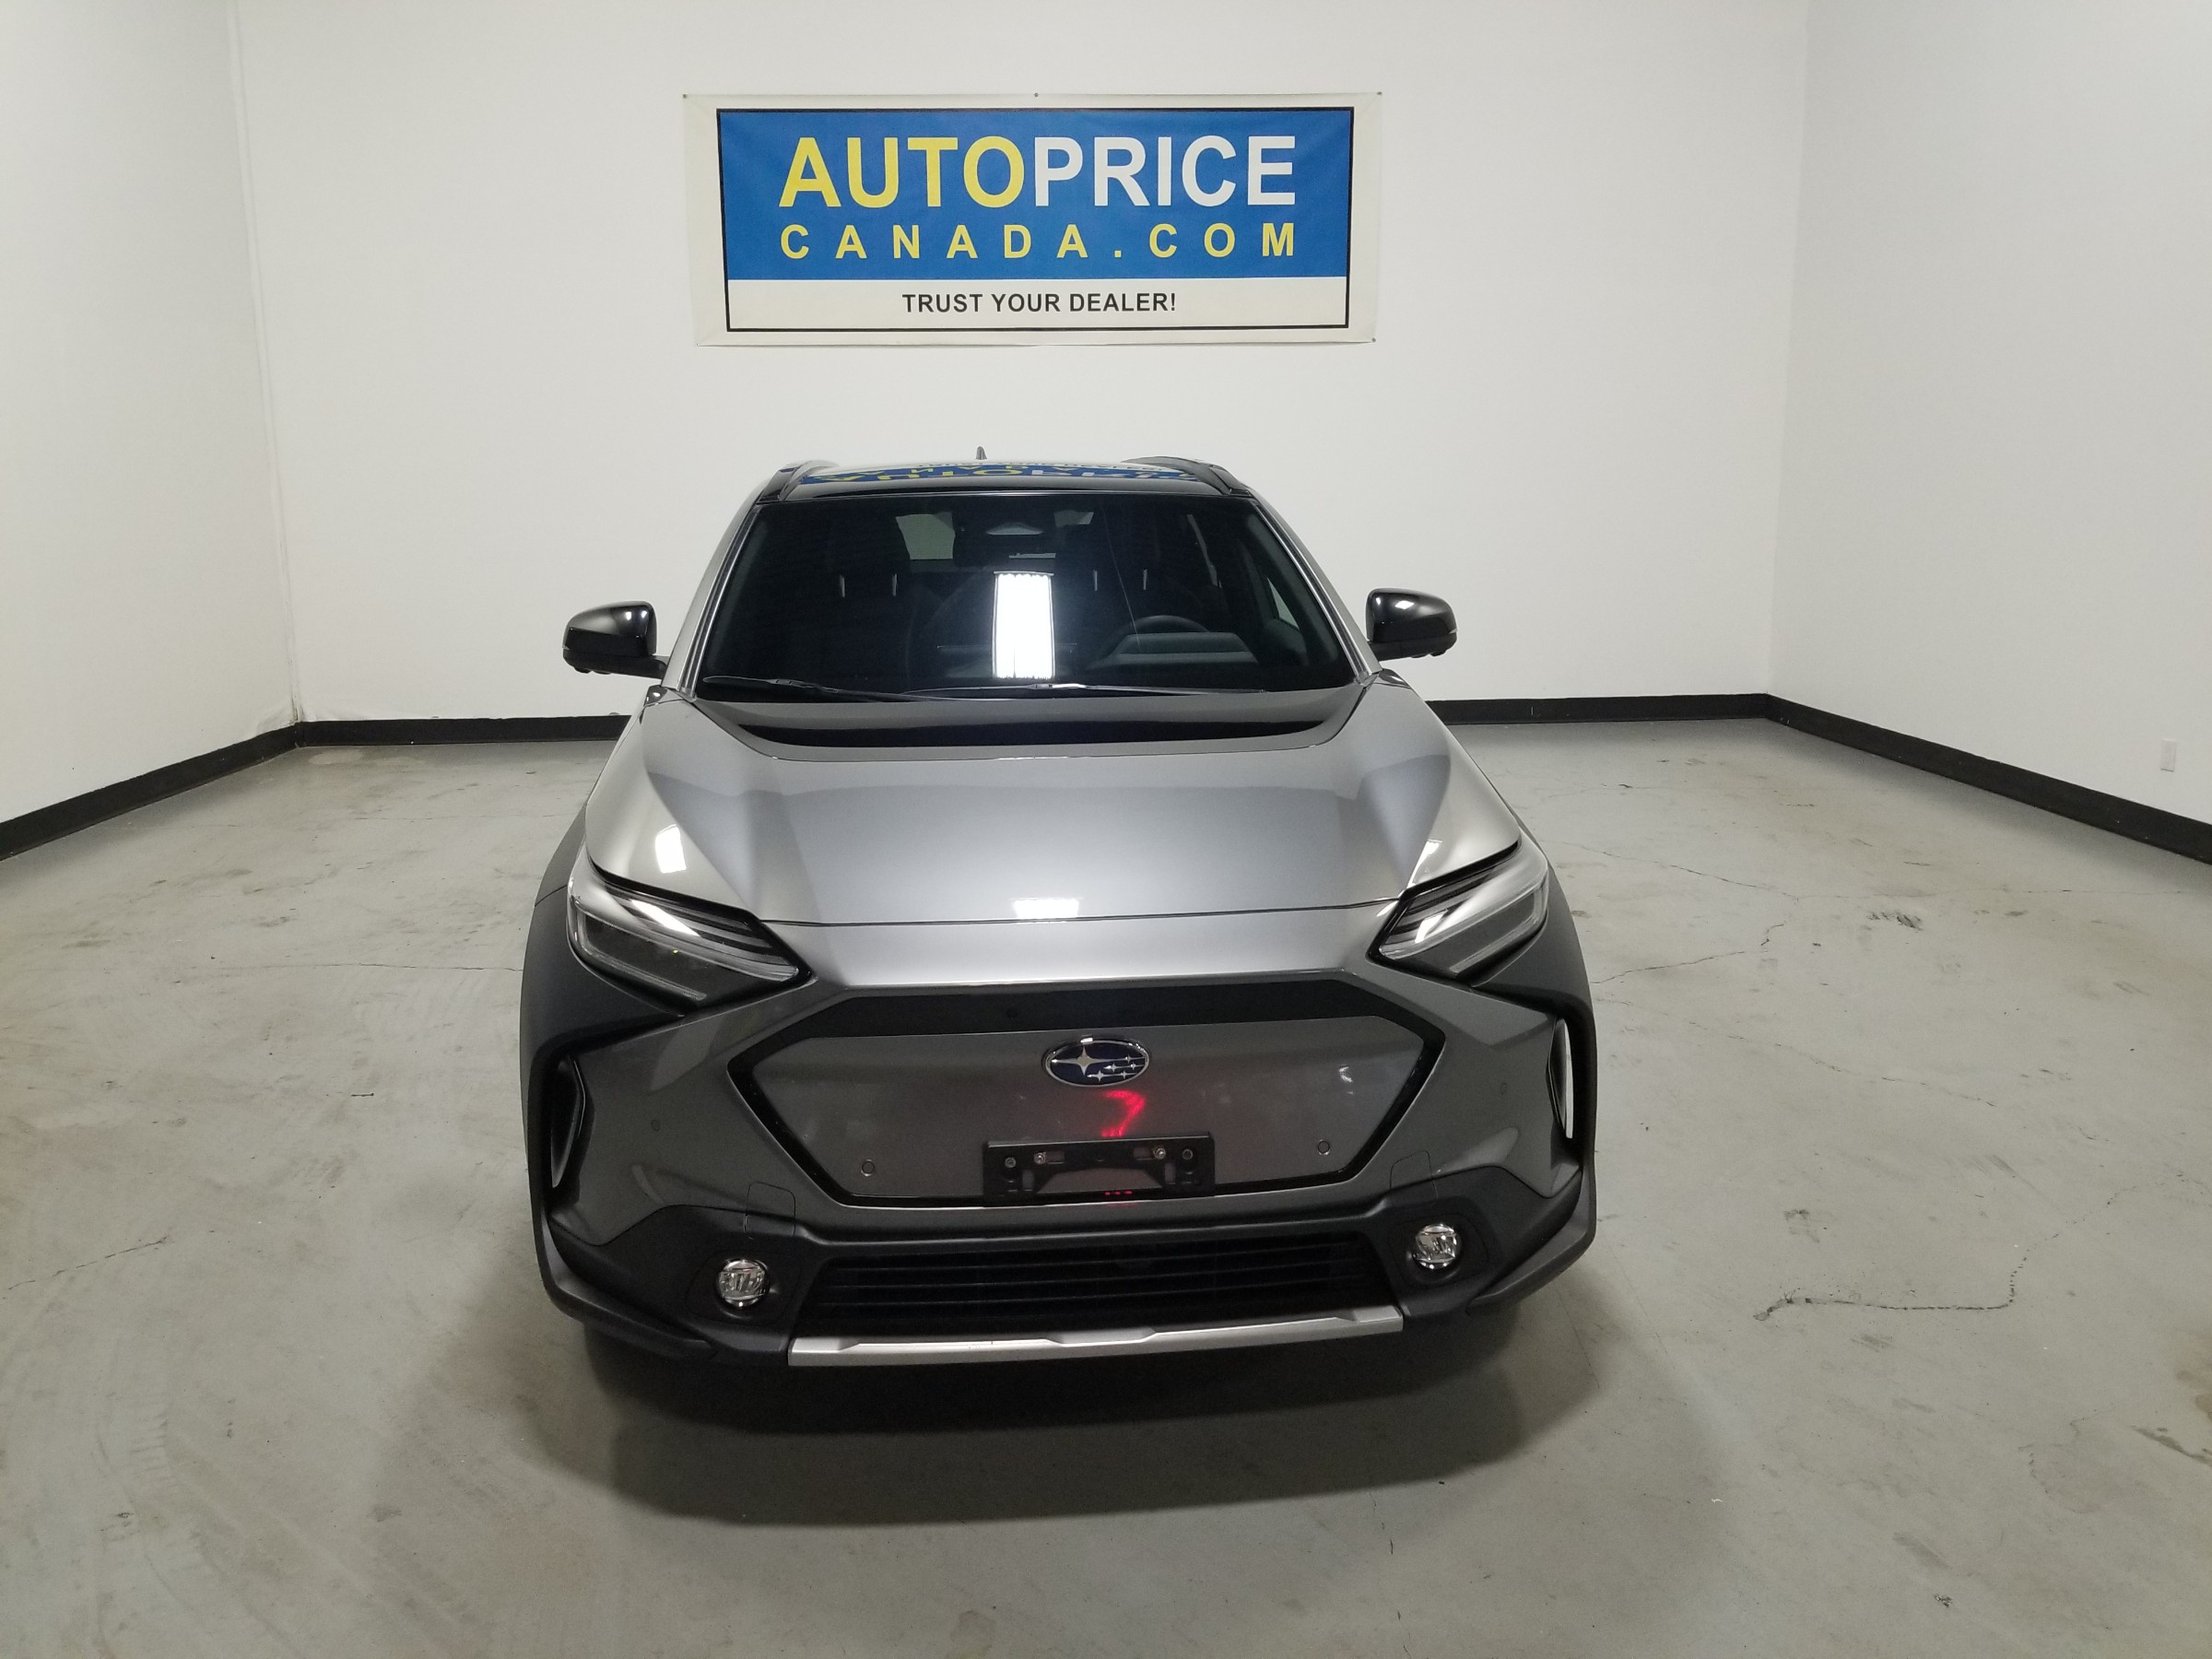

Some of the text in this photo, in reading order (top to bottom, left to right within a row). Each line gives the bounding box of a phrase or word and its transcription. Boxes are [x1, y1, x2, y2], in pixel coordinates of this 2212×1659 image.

[779, 135, 1296, 207] AUTOPRICE
[780, 223, 1294, 260] CANADA.COM
[902, 292, 1176, 312] TRUST YOUR DEALER!
